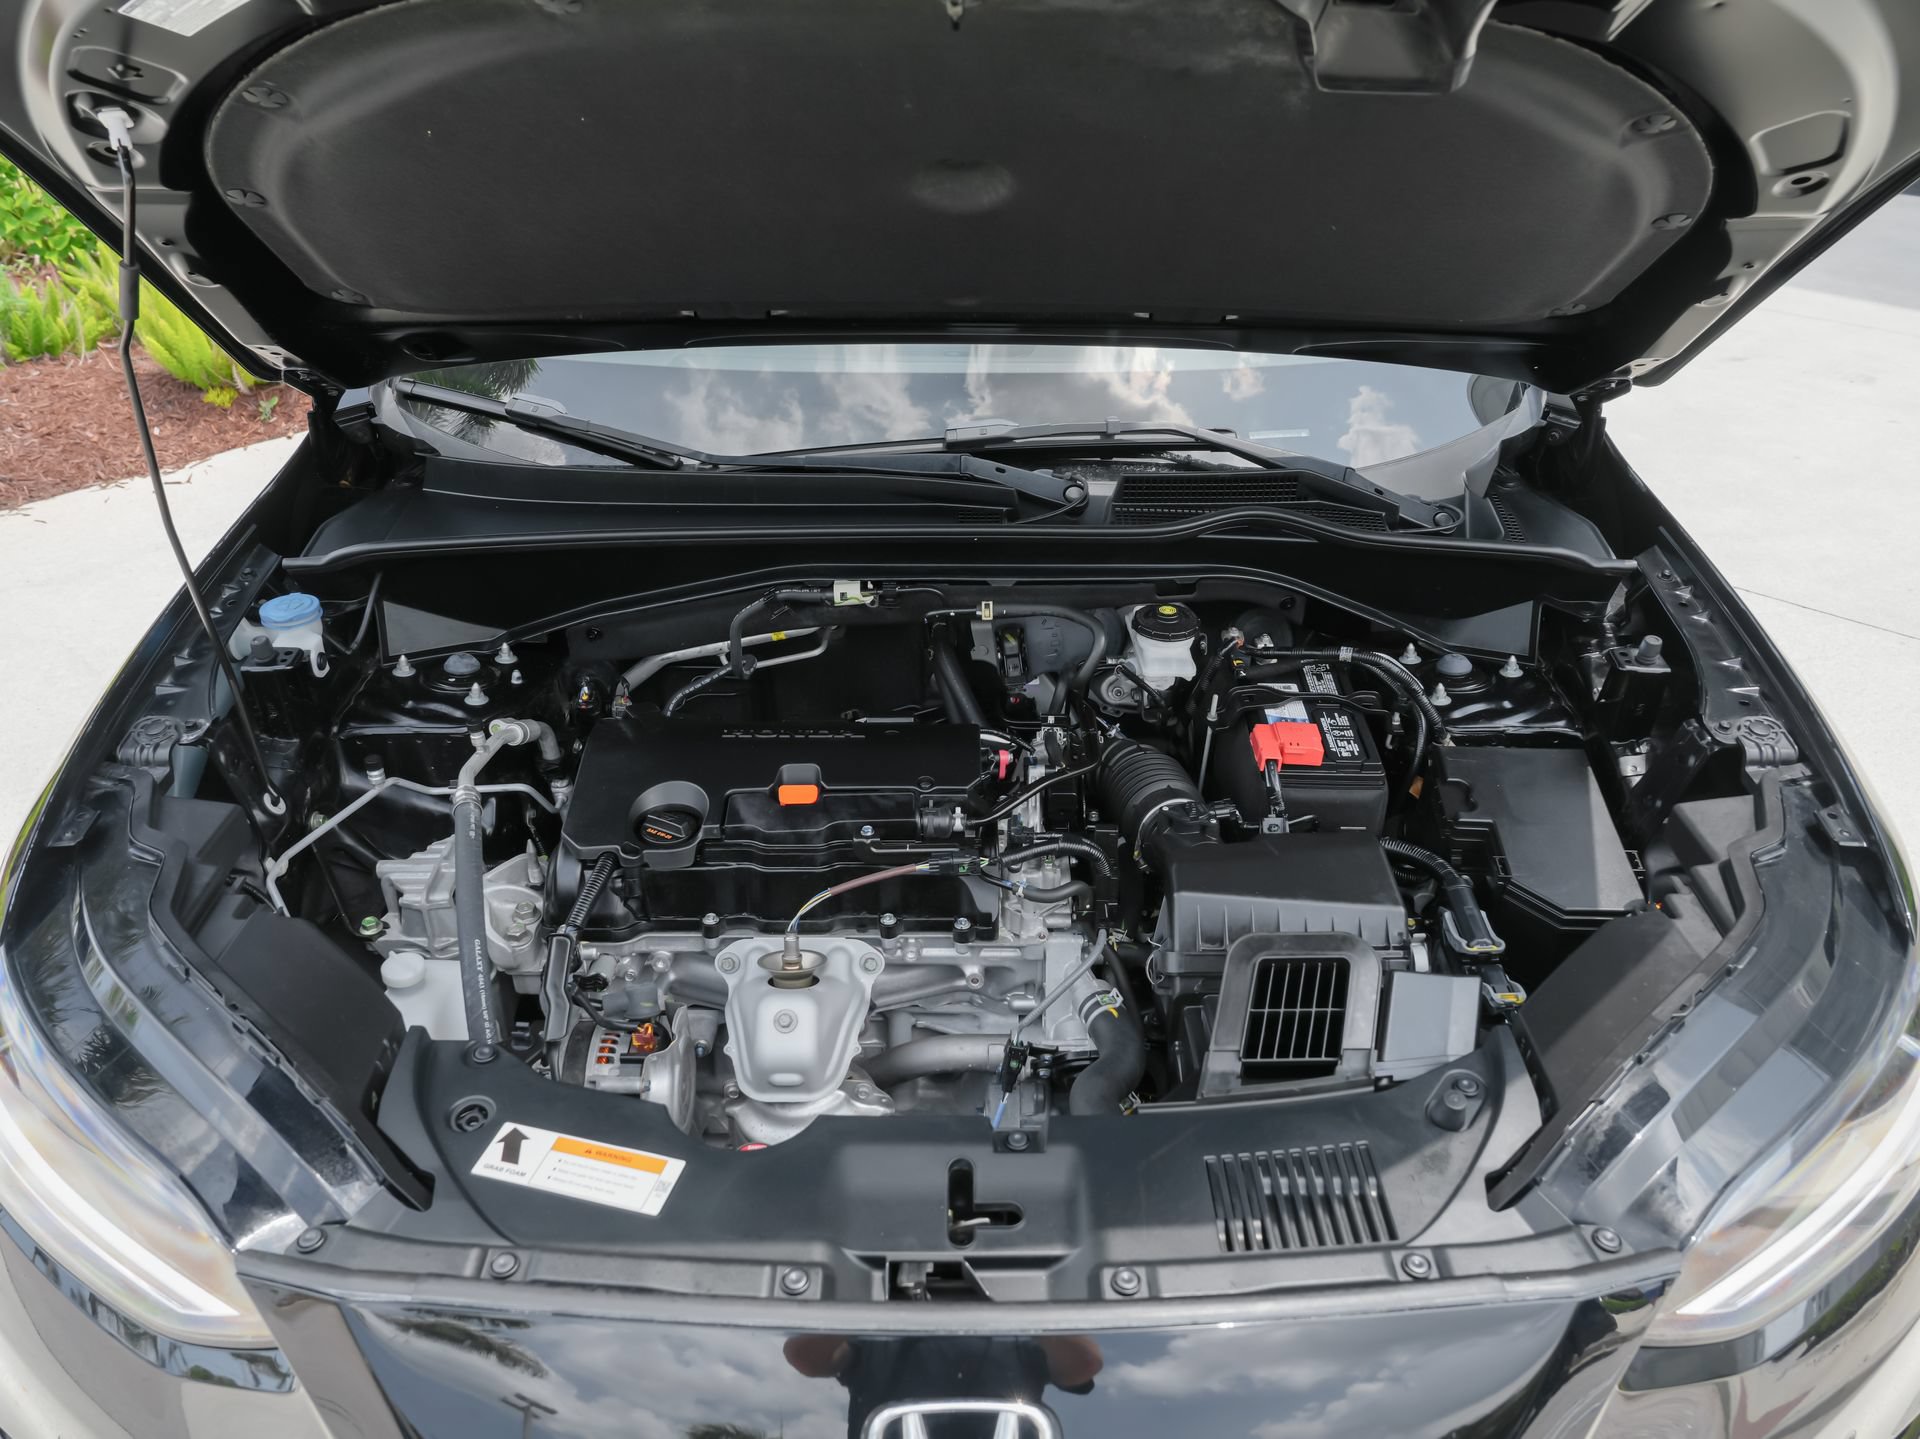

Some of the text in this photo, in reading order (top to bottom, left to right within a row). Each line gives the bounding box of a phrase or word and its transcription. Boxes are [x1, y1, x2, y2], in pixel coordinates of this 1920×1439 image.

[474, 939, 484, 972] GALAXY
[594, 1150, 633, 1163] WARNING
[483, 1163, 528, 1177] GRAB FOAM
